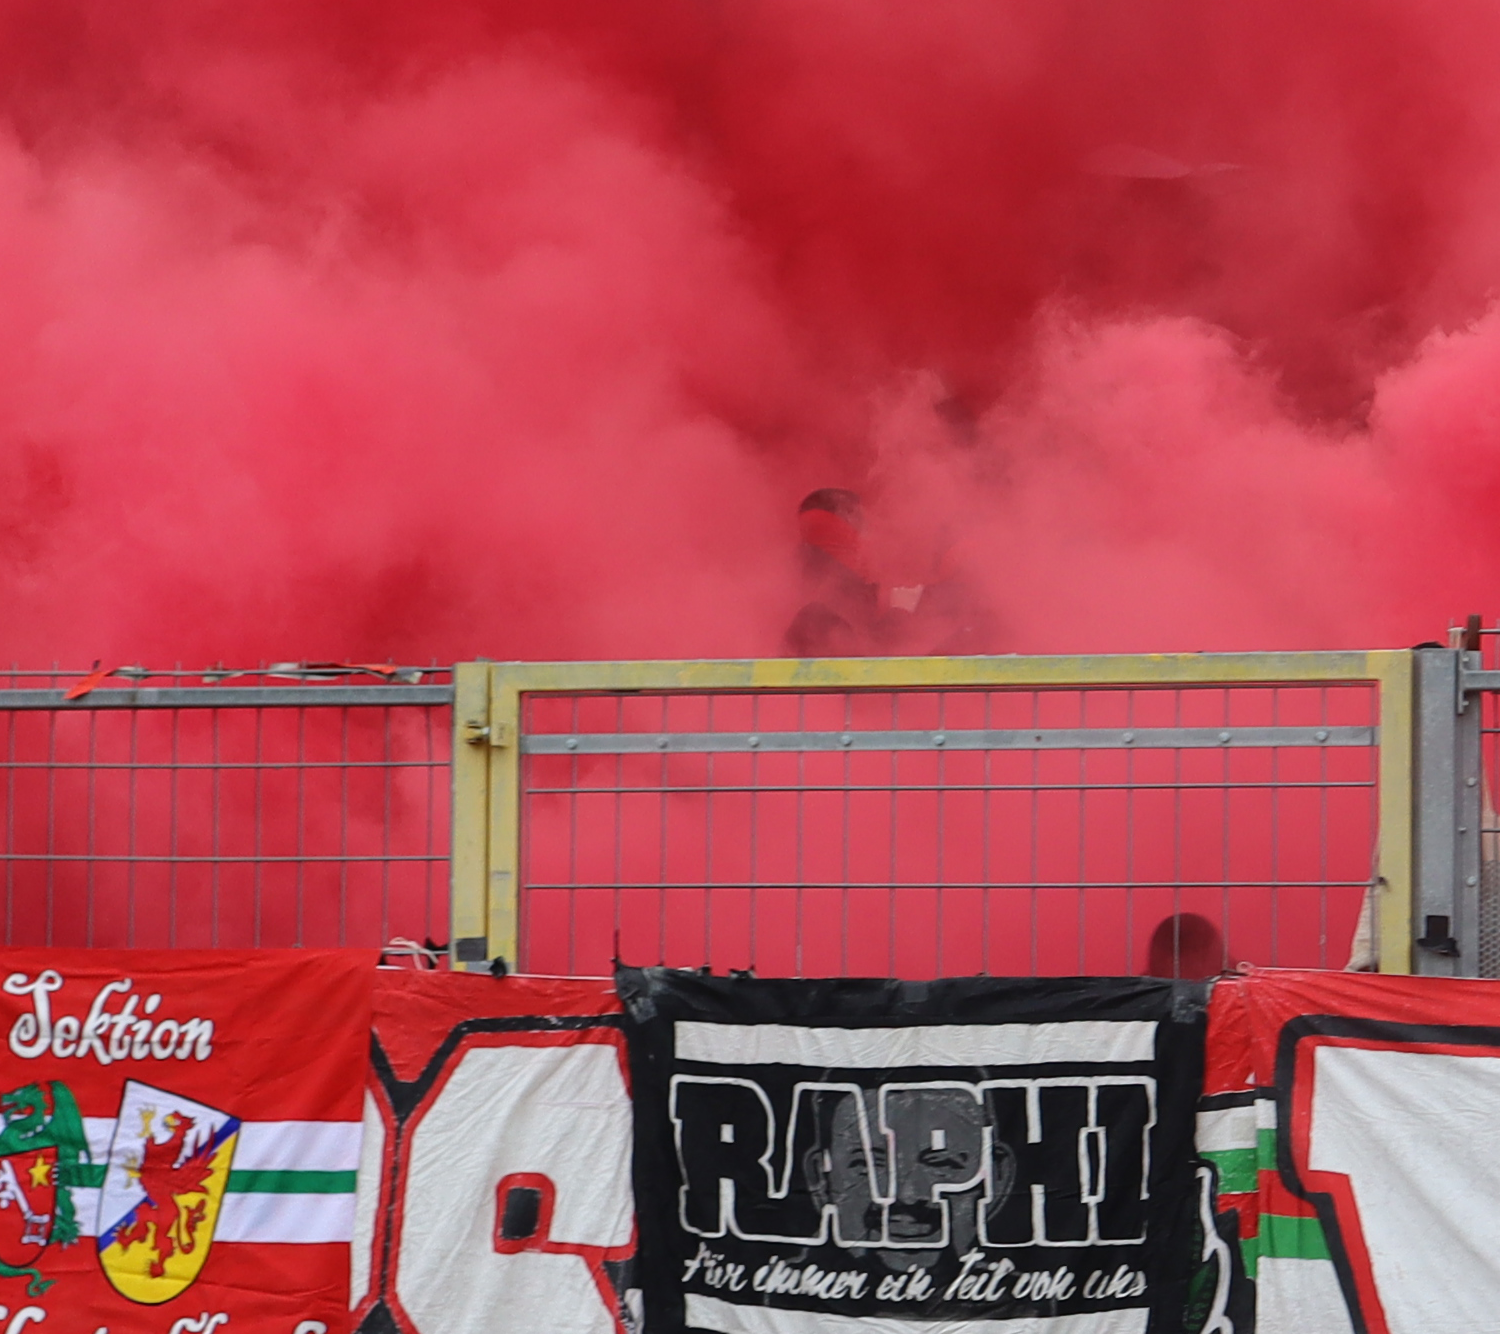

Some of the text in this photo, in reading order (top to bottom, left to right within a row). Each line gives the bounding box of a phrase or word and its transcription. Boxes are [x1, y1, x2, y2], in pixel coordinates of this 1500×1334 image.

[3, 969, 215, 1064] Sektion
[668, 1073, 1157, 1249] RAPHI
[752, 1255, 872, 1302] immer
[876, 1263, 938, 1303] ein
[1012, 1265, 1078, 1303] von
[1082, 1263, 1150, 1301] uns
